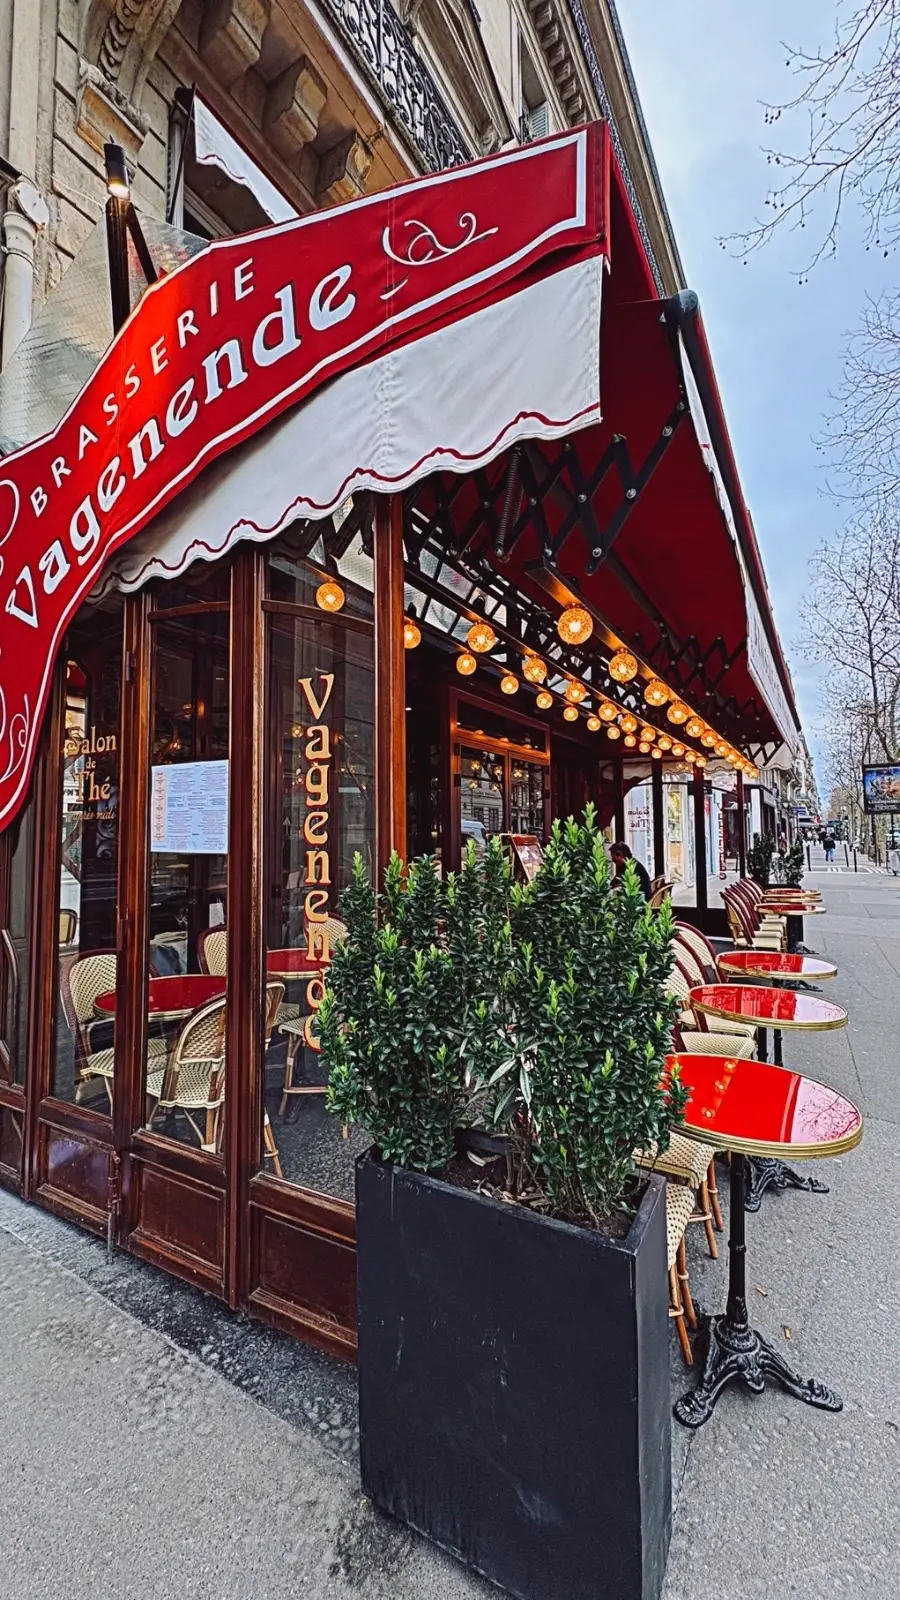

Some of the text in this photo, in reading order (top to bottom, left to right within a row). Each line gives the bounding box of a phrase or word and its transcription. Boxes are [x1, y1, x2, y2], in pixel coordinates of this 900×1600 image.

[30, 258, 255, 518] BRASSERIE
[4, 264, 357, 630] Vagenende
[65, 726, 117, 757] Salon
[85, 756, 97, 769] de
[72, 771, 111, 802] Thé
